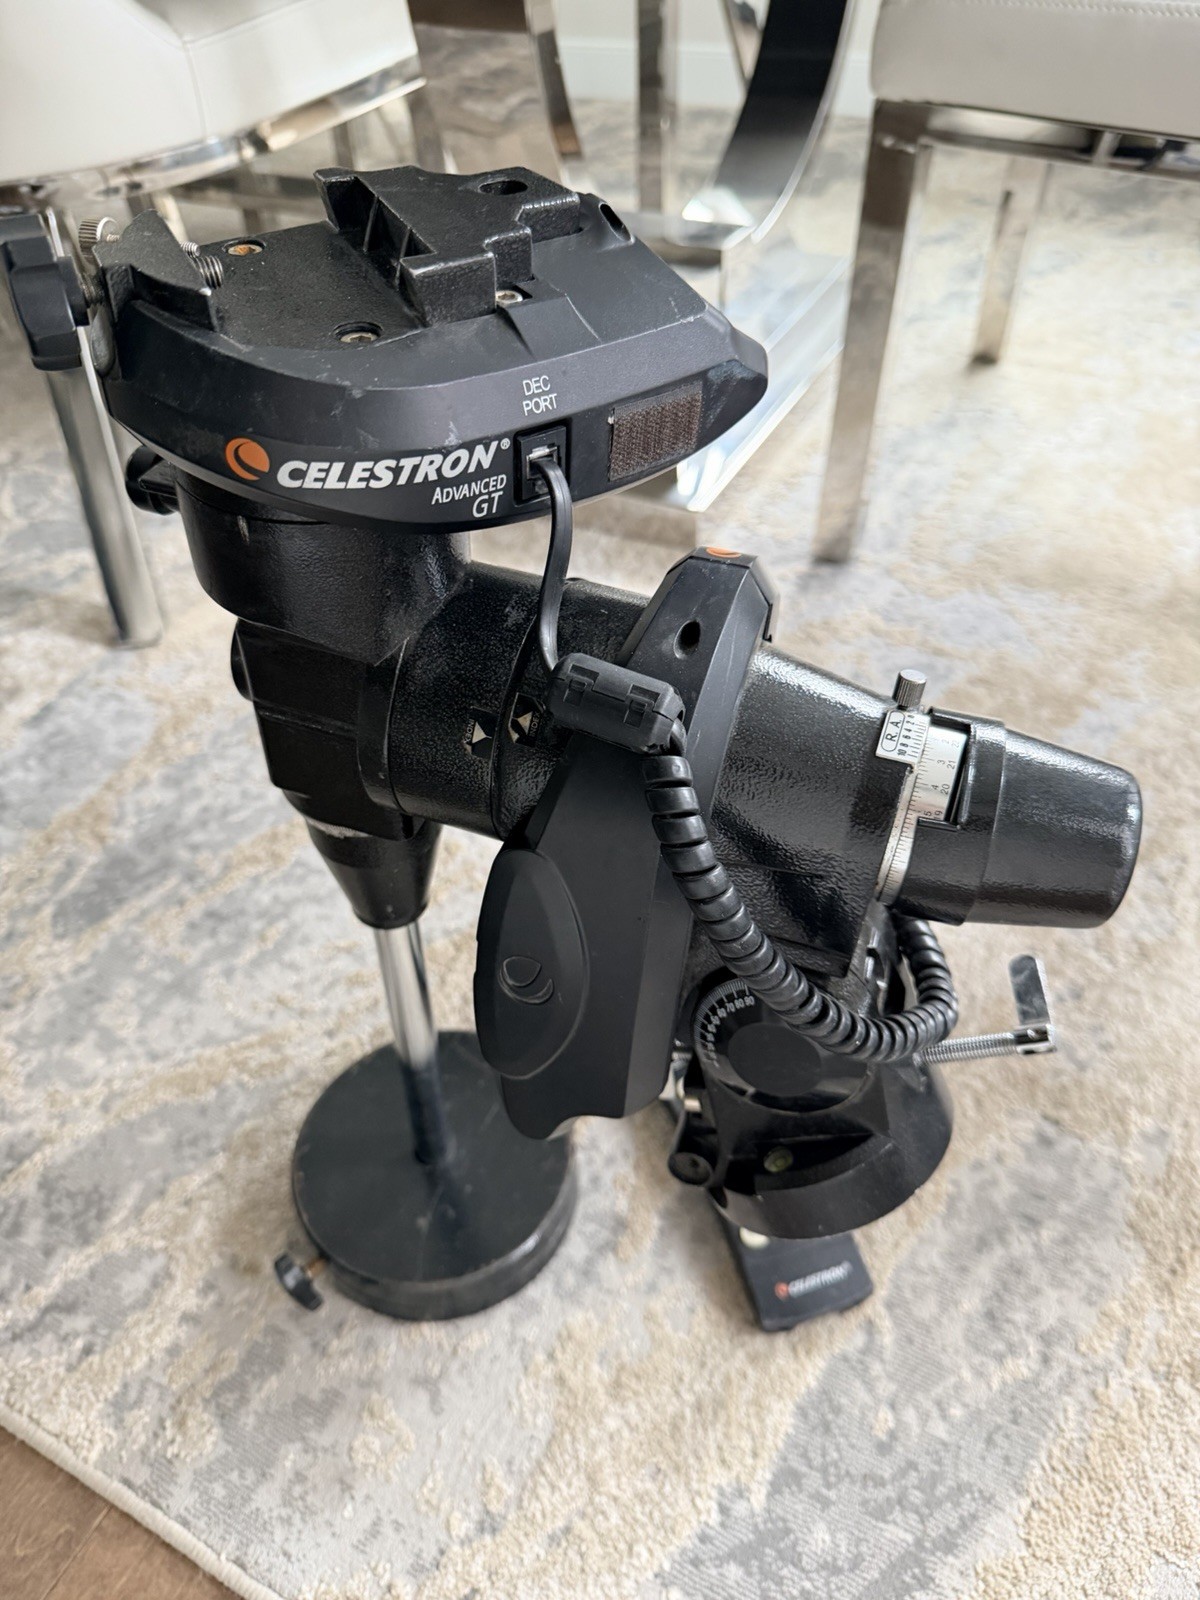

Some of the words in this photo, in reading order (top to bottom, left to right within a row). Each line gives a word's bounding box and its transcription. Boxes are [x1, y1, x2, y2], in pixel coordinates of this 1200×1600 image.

[522, 375, 551, 396] DEC
[523, 393, 557, 416] PORT
[431, 474, 507, 505] ADVANCED
[472, 491, 503, 518] GT
[940, 783, 950, 796] 20
[946, 760, 956, 770] 21
